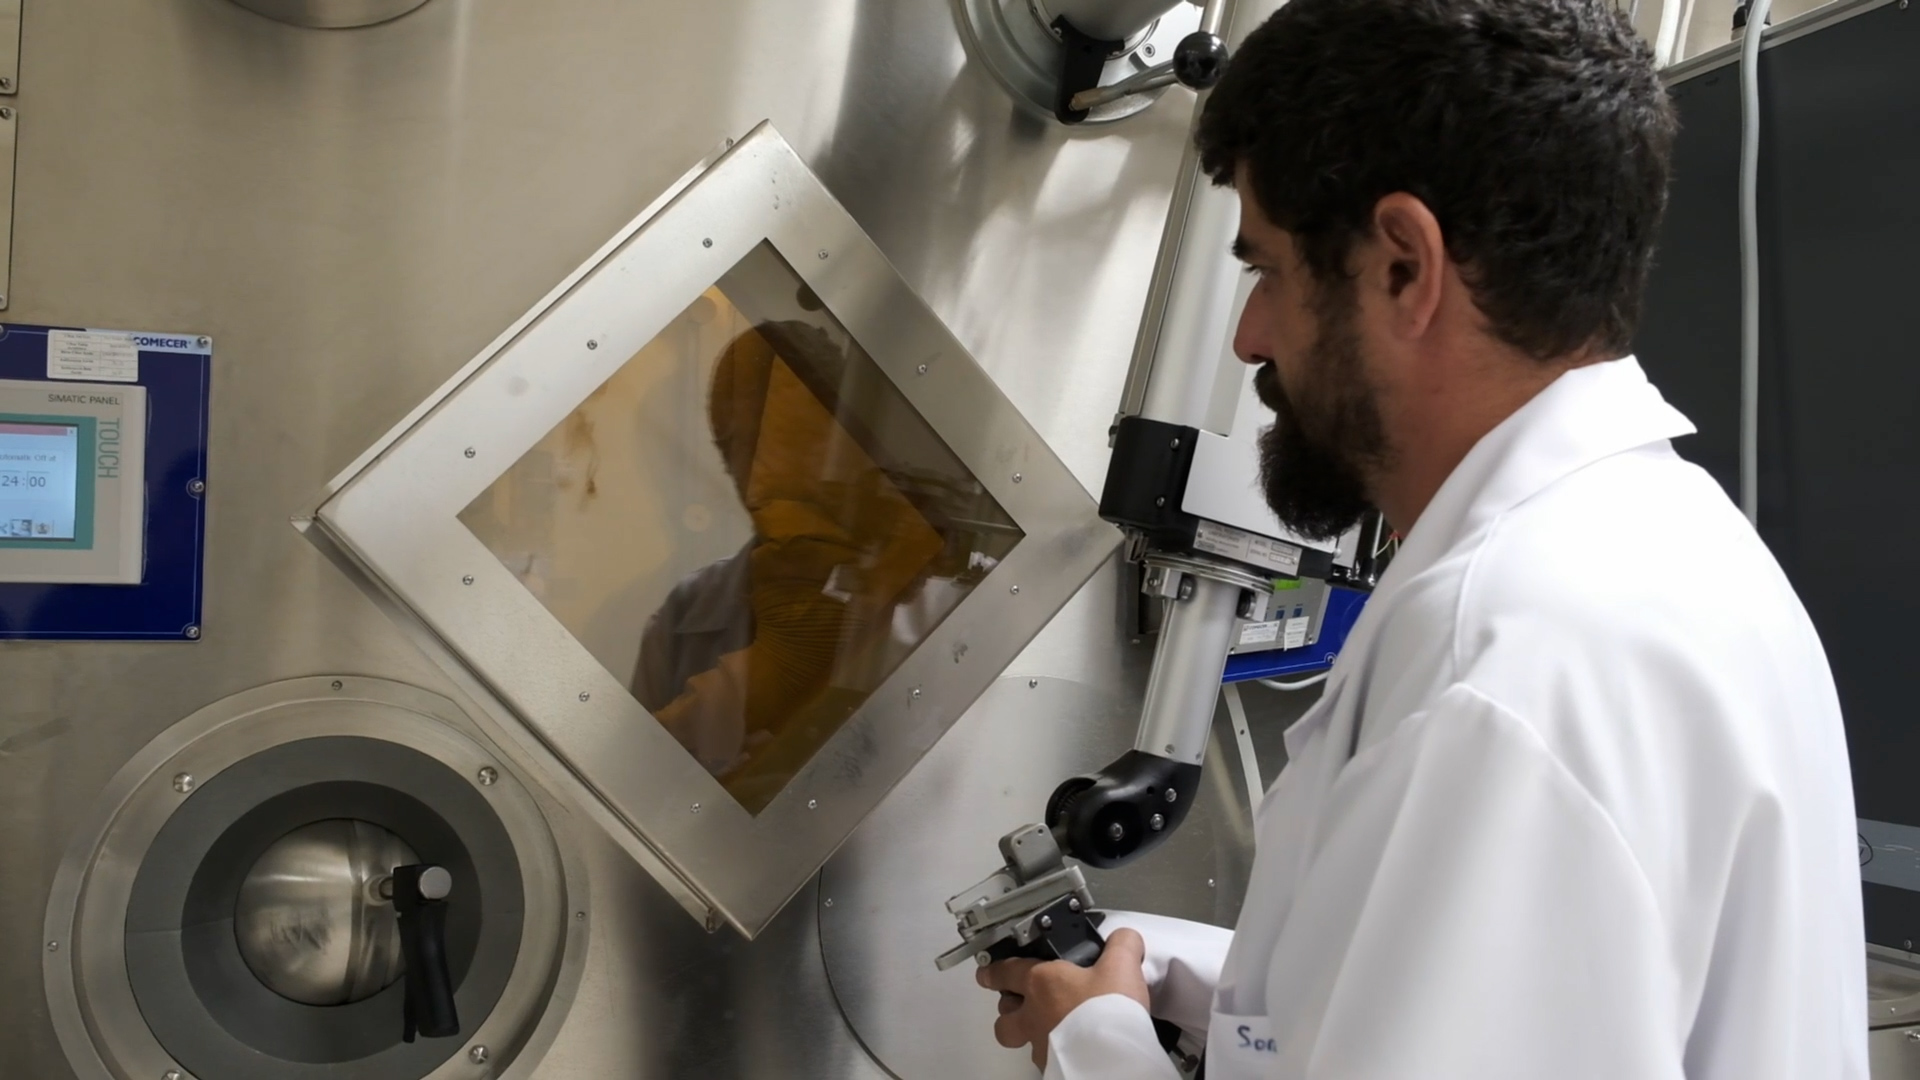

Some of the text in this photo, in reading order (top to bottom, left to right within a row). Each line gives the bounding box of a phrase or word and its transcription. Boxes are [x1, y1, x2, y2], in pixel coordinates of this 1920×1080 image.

[48, 393, 120, 405] SIMATIC PANEL
[98, 418, 120, 478] TOUCH
